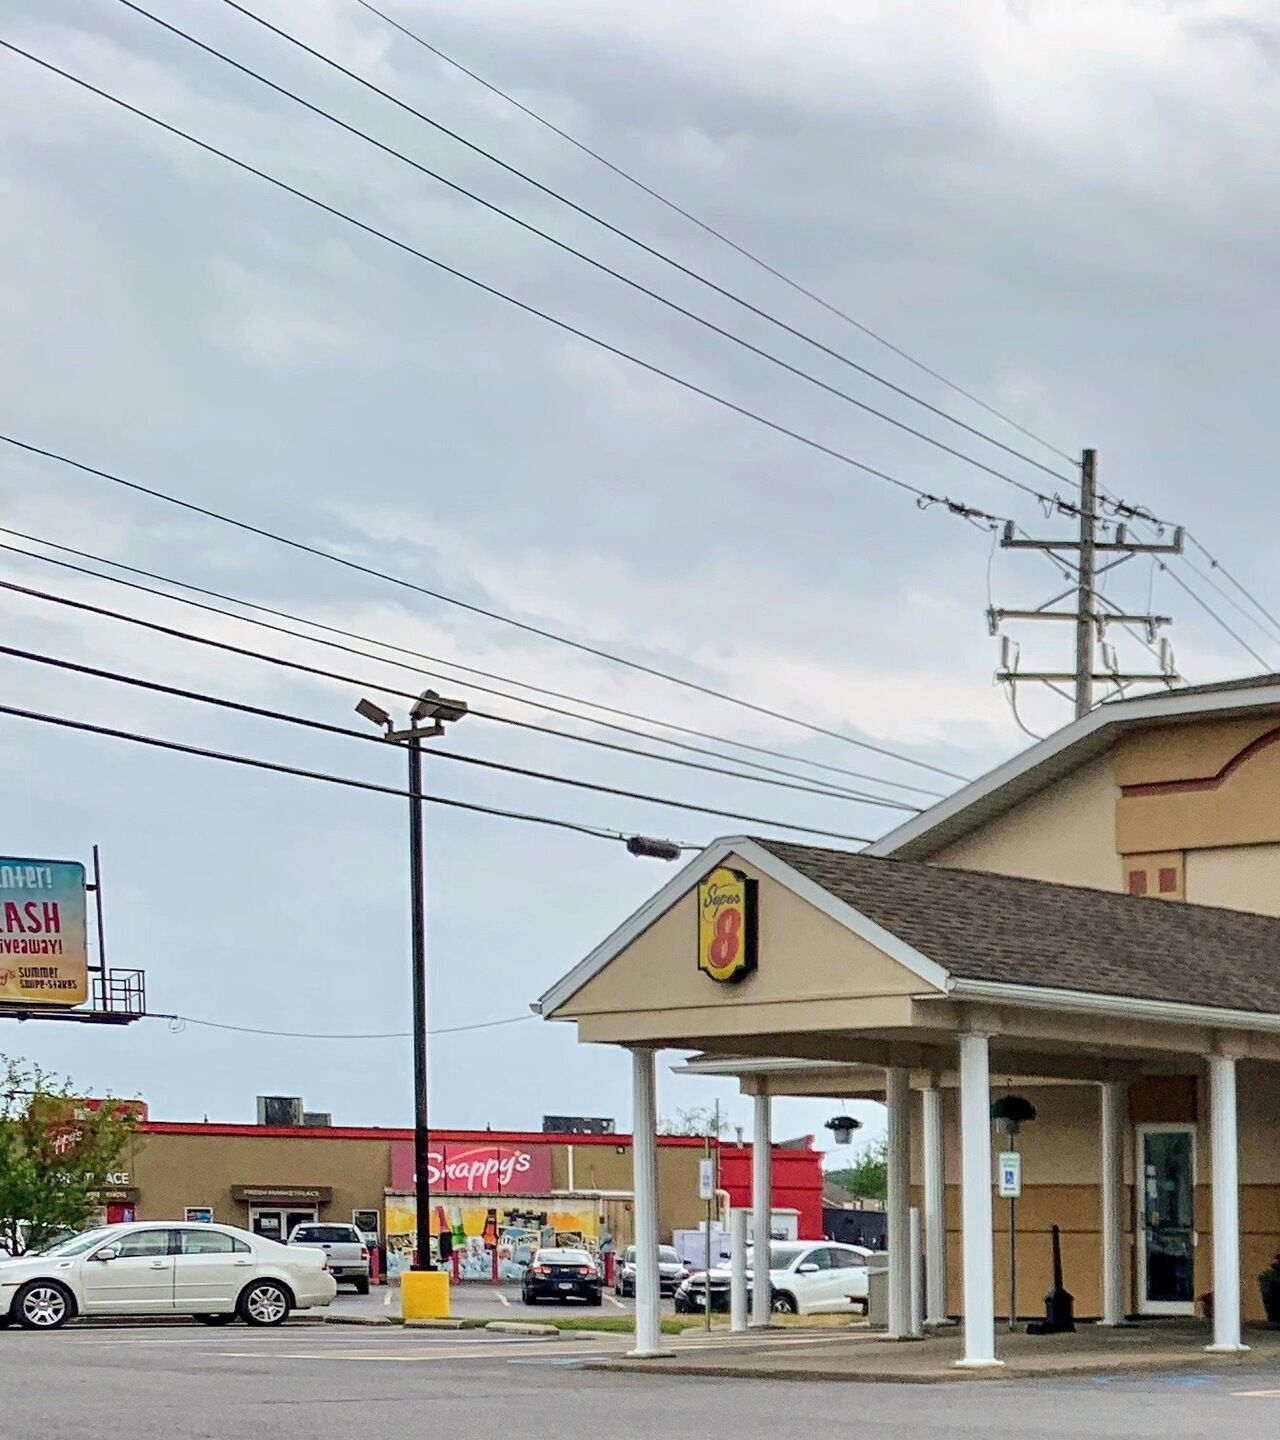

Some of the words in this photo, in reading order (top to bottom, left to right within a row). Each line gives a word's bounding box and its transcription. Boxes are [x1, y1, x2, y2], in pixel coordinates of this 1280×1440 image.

[0, 866, 53, 889] nter!
[0, 901, 60, 933] ASH
[702, 883, 741, 921] Super
[0, 939, 63, 955] iveaway!
[708, 908, 742, 969] 8
[412, 1151, 532, 1191] Snappy's
